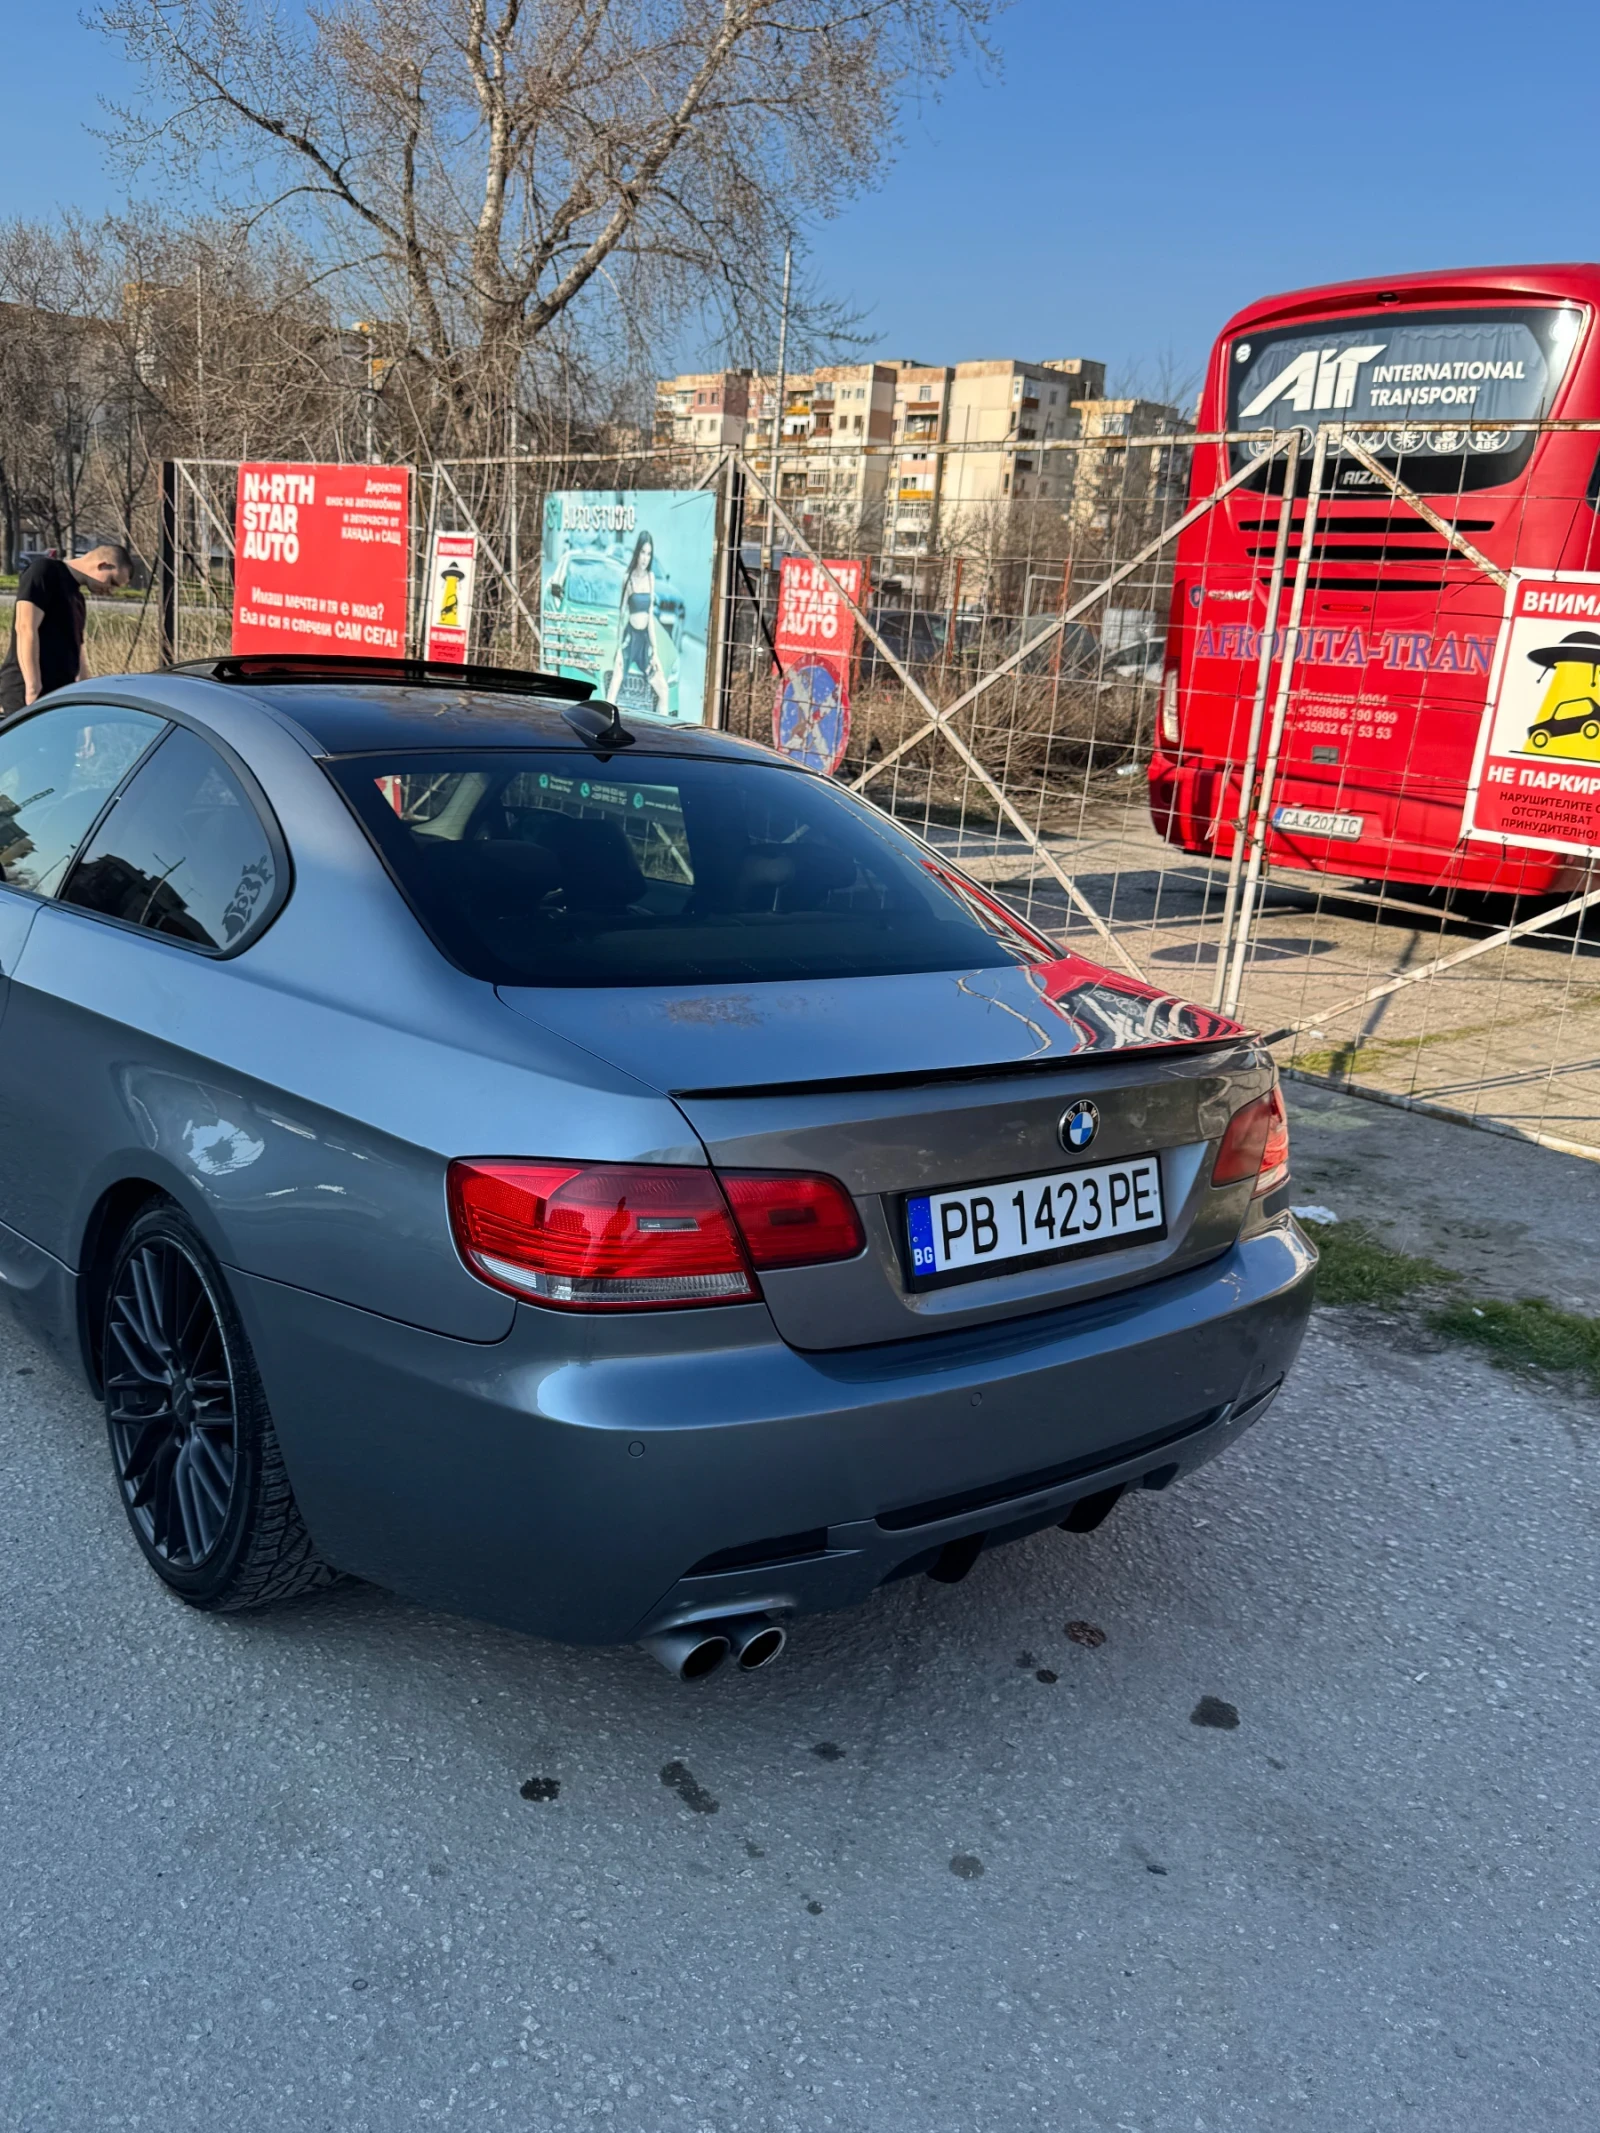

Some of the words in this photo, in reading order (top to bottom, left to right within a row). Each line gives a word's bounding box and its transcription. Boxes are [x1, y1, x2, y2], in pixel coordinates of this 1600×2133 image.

[1372, 361, 1526, 383] INTERNATIONAL
[1370, 386, 1478, 407] TRANSPORT
[243, 502, 299, 533] STAR
[390, 516, 399, 527] от
[243, 531, 300, 564] AUTO
[341, 527, 374, 543] КАНАДА
[381, 530, 402, 546] САЩ
[251, 586, 284, 607] Имаш
[284, 593, 317, 611] мечта
[319, 599, 326, 613] и
[327, 599, 338, 614] тя
[340, 601, 350, 616] е
[352, 602, 385, 621] кола?
[782, 588, 839, 614] STAR
[239, 607, 258, 625] Ела
[259, 613, 266, 626] и
[267, 614, 281, 629] си
[282, 616, 290, 630] я
[334, 620, 362, 642] САМ
[363, 625, 399, 648] СЕГА!
[781, 612, 838, 638] AUTO
[1374, 710, 1398, 724] 999
[1357, 725, 1374, 738] 53
[1375, 727, 1392, 740] 53
[1487, 764, 1516, 784] НЕ
[1499, 791, 1593, 813] НАРУШИТЕЛИТЕ
[1281, 811, 1299, 826] CA
[1303, 813, 1337, 831] 4207
[1341, 818, 1359, 835] TC
[1512, 806, 1593, 826] ОТСТРАНЯВАТ
[1501, 817, 1598, 840] ПРИНУДИТЕЛНО!
[1066, 1101, 1099, 1123] BMW
[940, 1196, 998, 1261] PB
[1012, 1178, 1102, 1246] 1423
[1108, 1167, 1154, 1228] PE
[914, 1246, 934, 1266] BG
